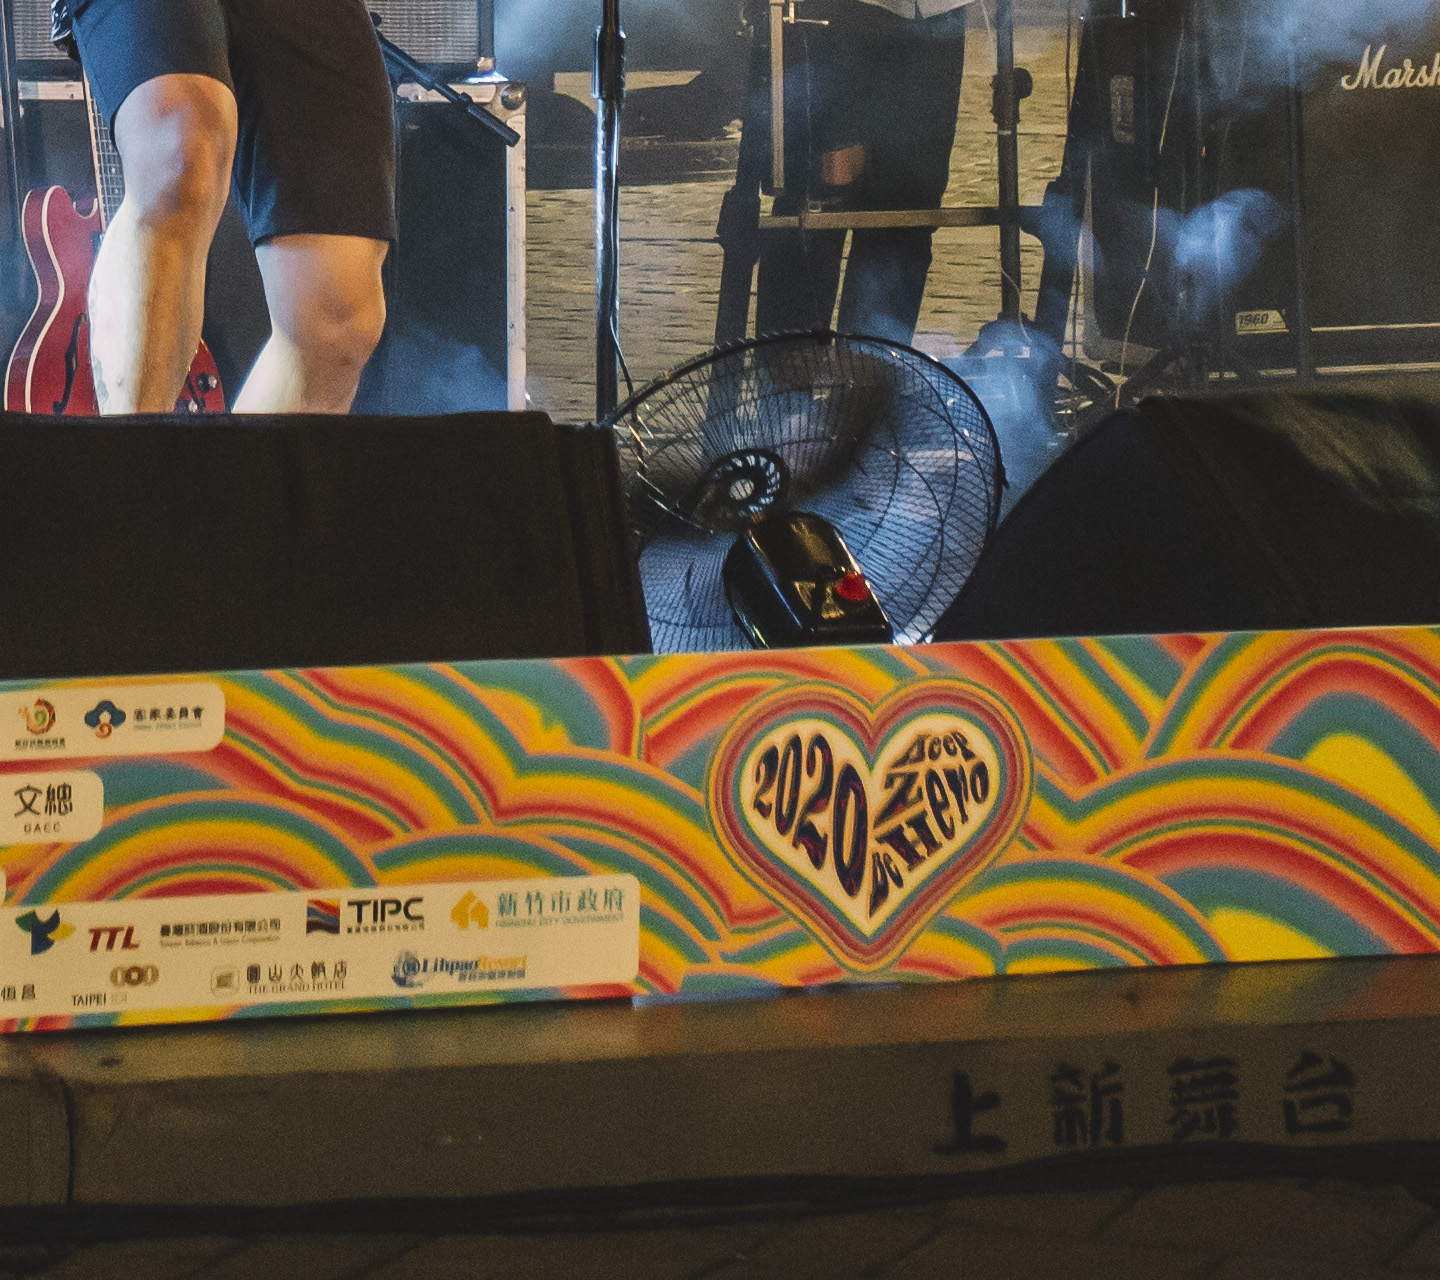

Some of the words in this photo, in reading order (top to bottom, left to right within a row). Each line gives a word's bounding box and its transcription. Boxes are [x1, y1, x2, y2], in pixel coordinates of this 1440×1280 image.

[14, 782, 73, 819] 文總
[753, 733, 868, 897] 2020
[347, 896, 424, 924] TIPC
[497, 887, 624, 917] 新竹市政府
[88, 926, 140, 952] TTL
[72, 993, 107, 1007] TAIPEI
[933, 1050, 1356, 1156] 上新舞台
